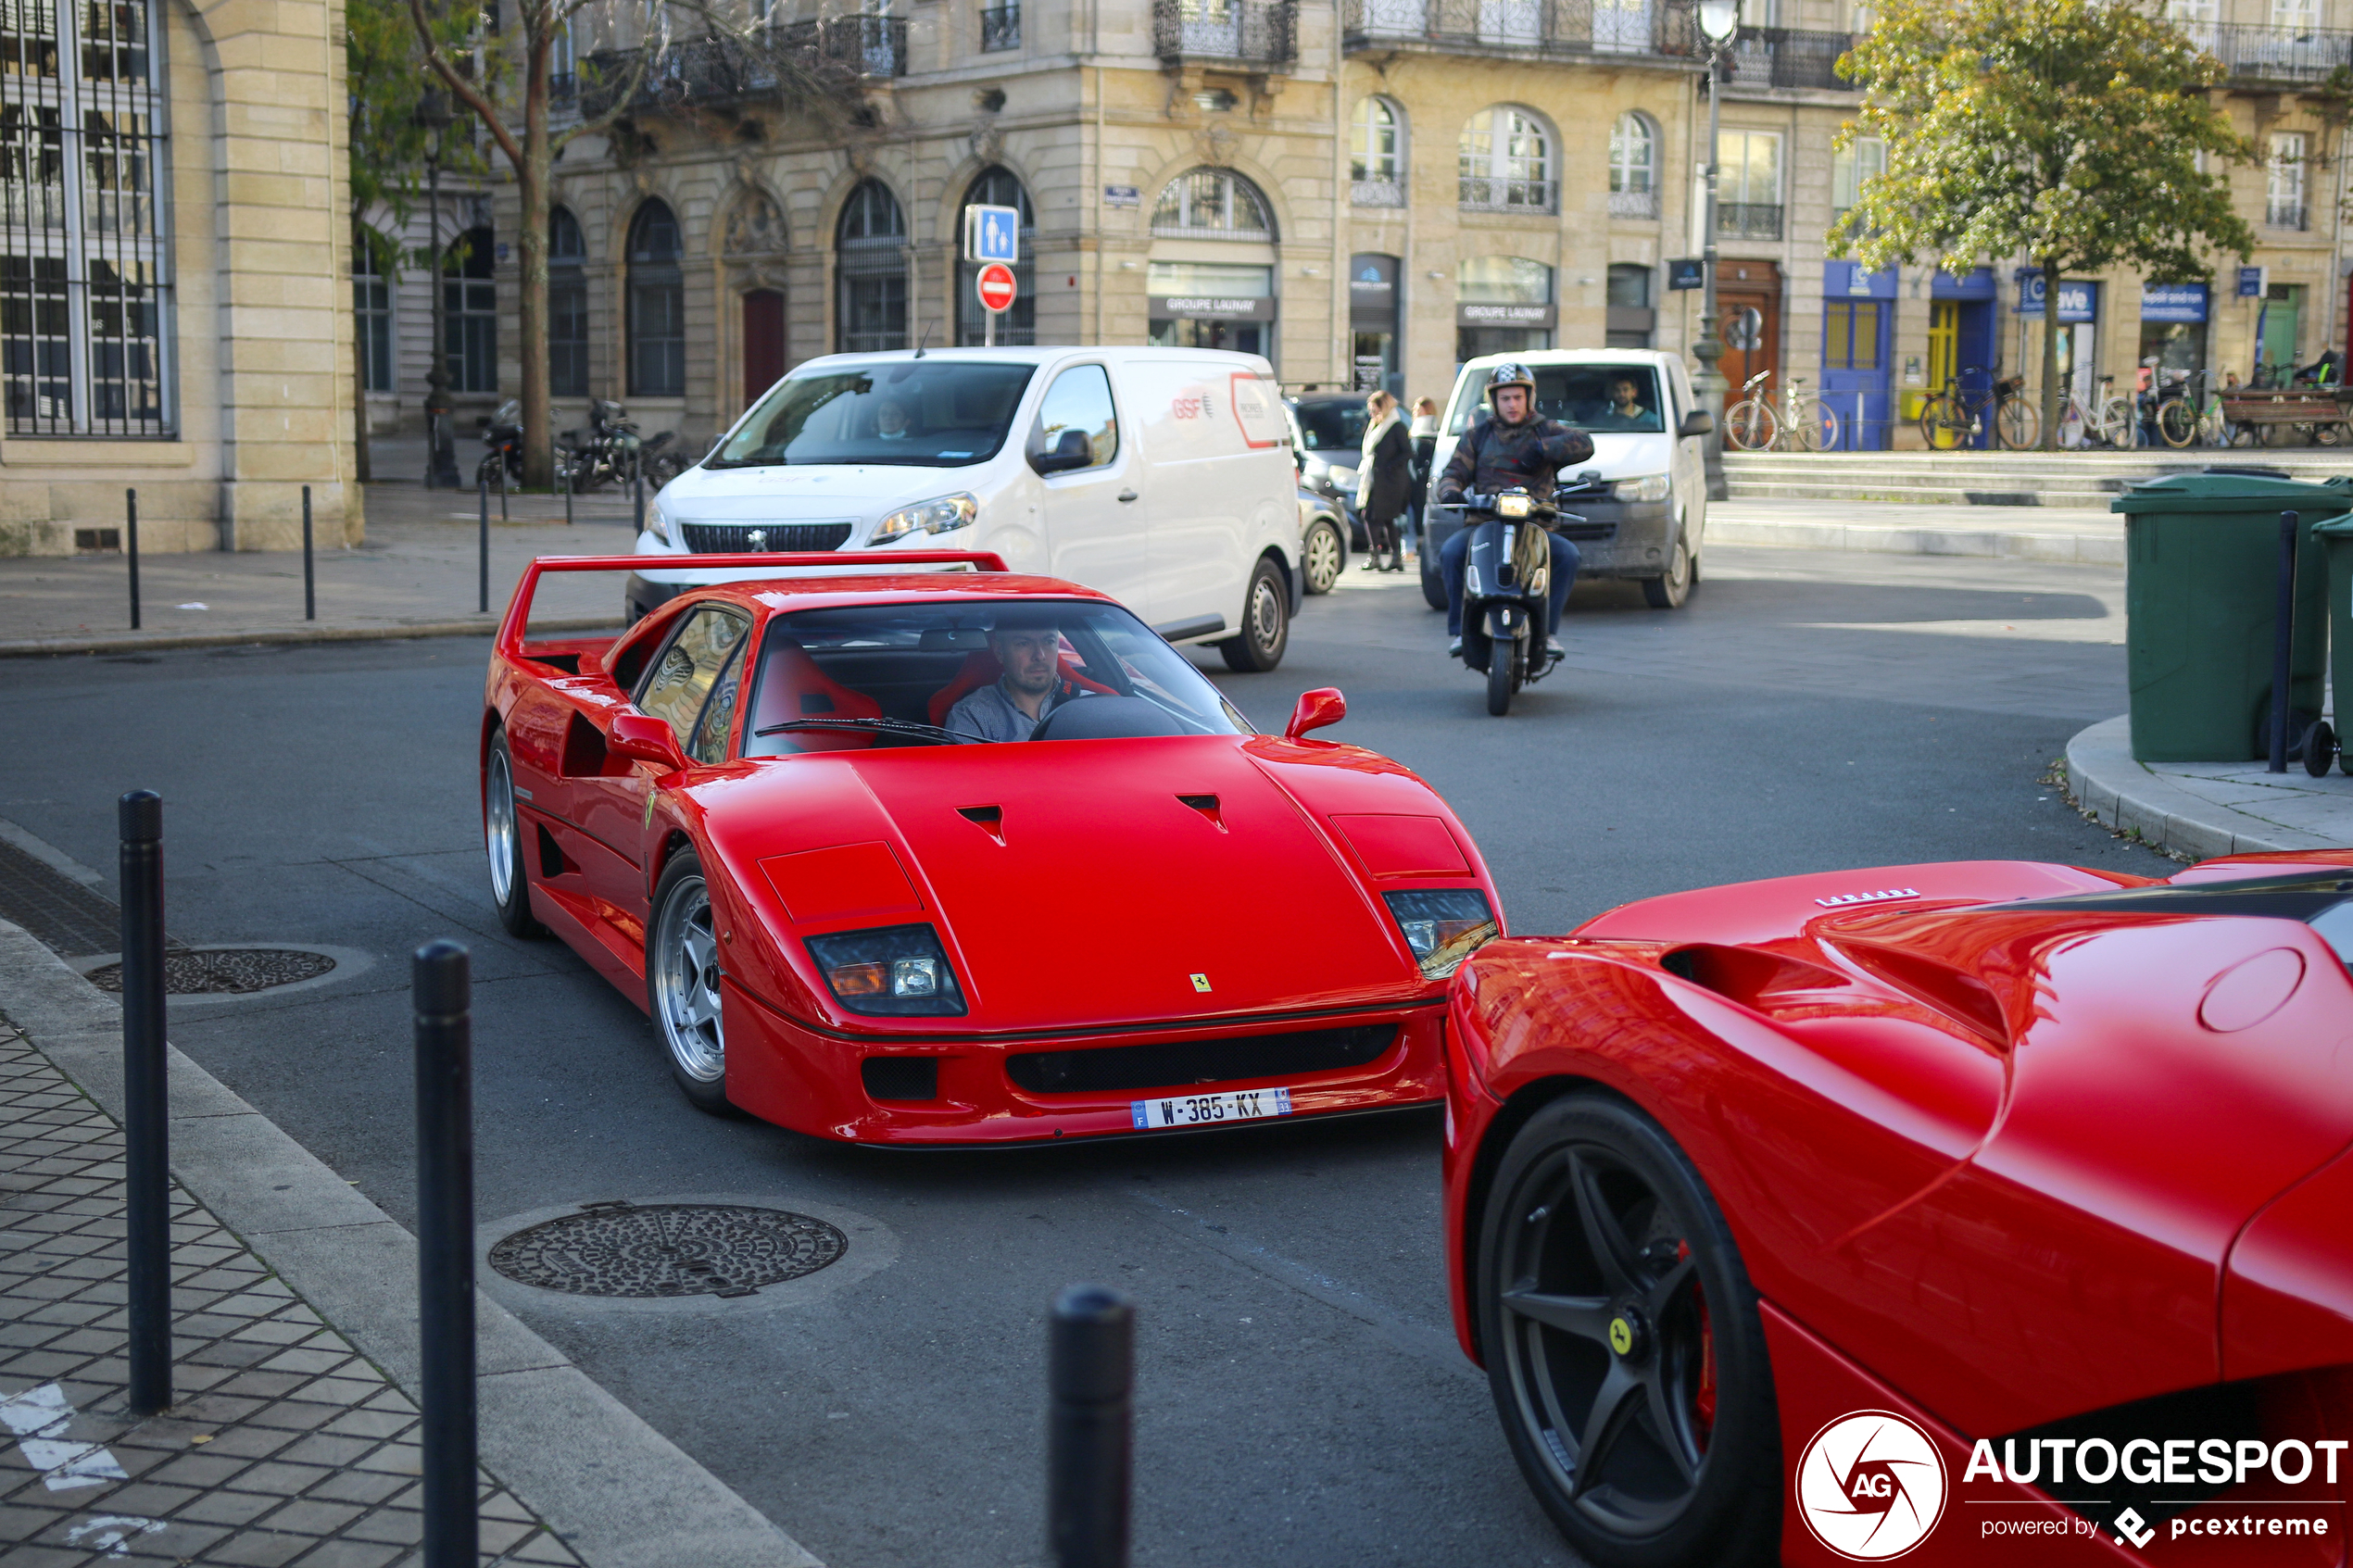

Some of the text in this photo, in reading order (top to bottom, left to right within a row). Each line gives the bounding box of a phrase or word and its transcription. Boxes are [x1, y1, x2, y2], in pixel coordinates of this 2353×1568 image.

[1166, 297, 1256, 312] GROUPE LAUNAY
[1465, 306, 1546, 320] GROUPE LAUNAY
[1172, 398, 1201, 420] GSF
[1279, 1102, 1290, 1112] 33
[1137, 1117, 1144, 1126] F
